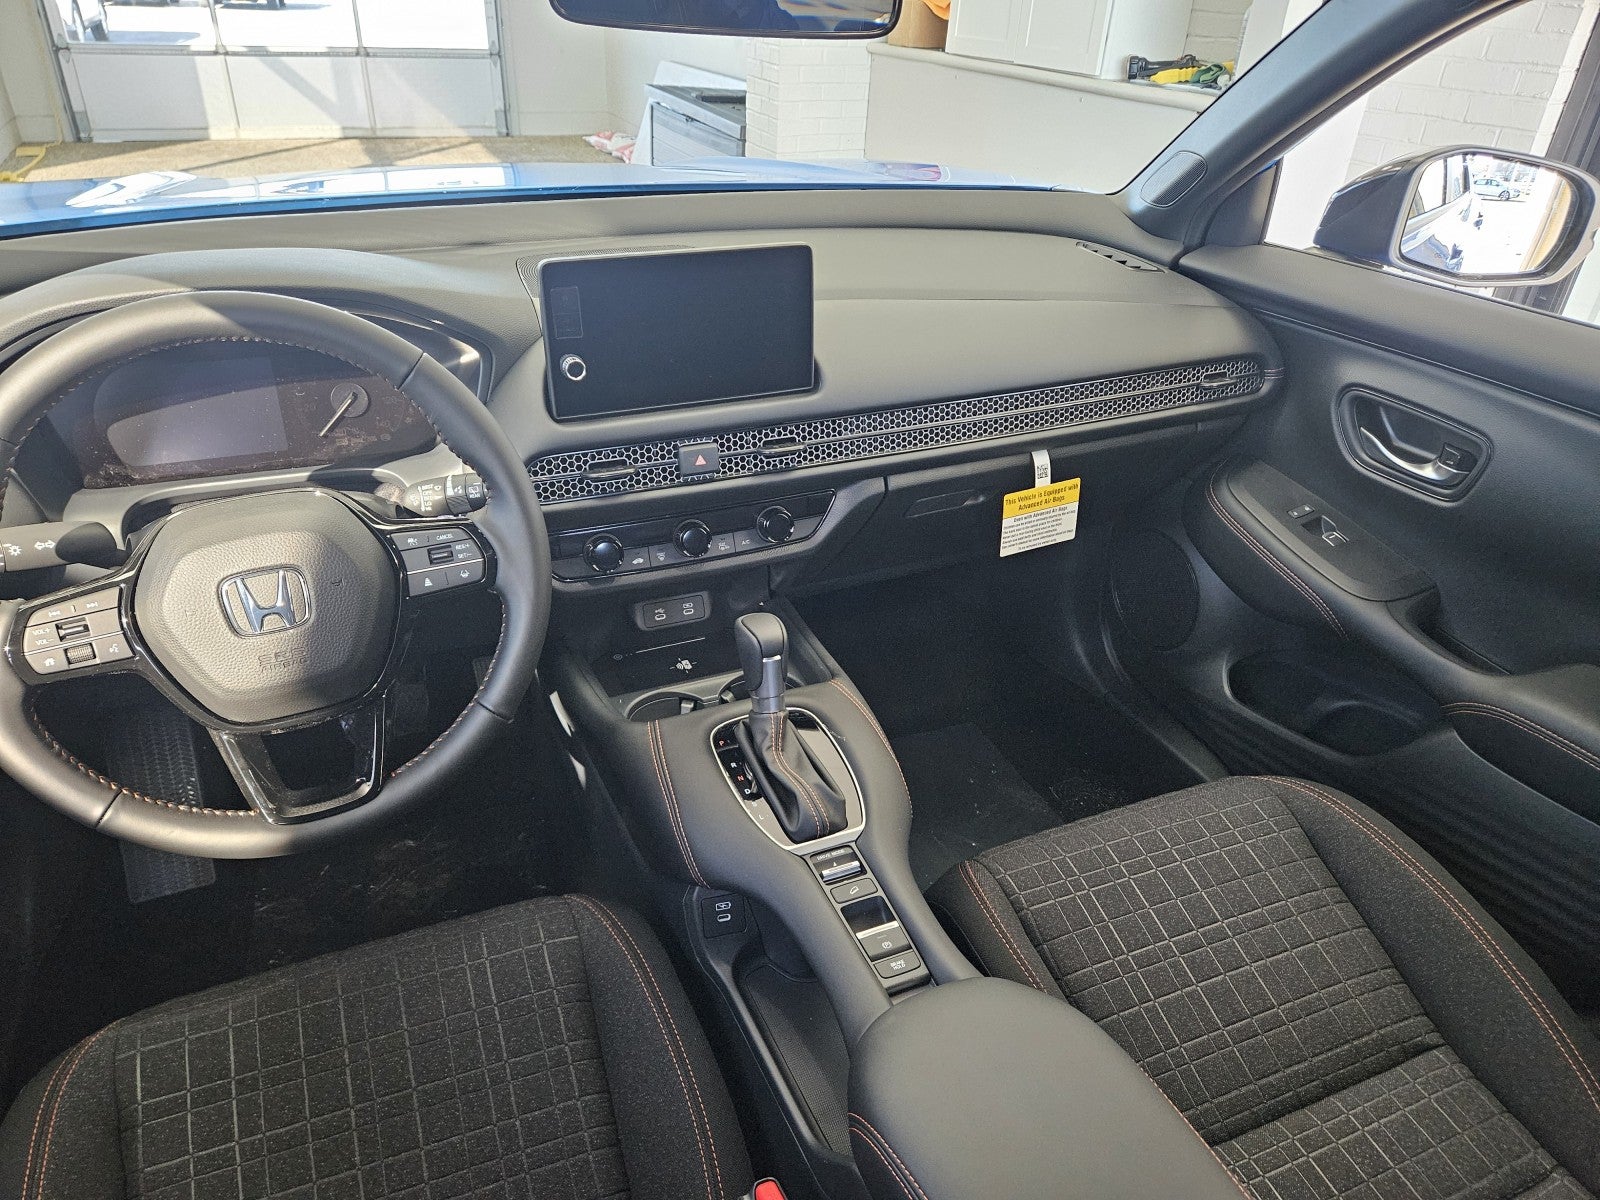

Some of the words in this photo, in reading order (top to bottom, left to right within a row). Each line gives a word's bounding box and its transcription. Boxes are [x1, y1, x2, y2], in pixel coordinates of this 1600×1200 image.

[1018, 493, 1036, 502] Vehicle
[1044, 486, 1066, 497] Equipped
[1018, 500, 1042, 510] Advanced
[1053, 495, 1065, 503] Bags
[1033, 510, 1051, 518] Advanced
